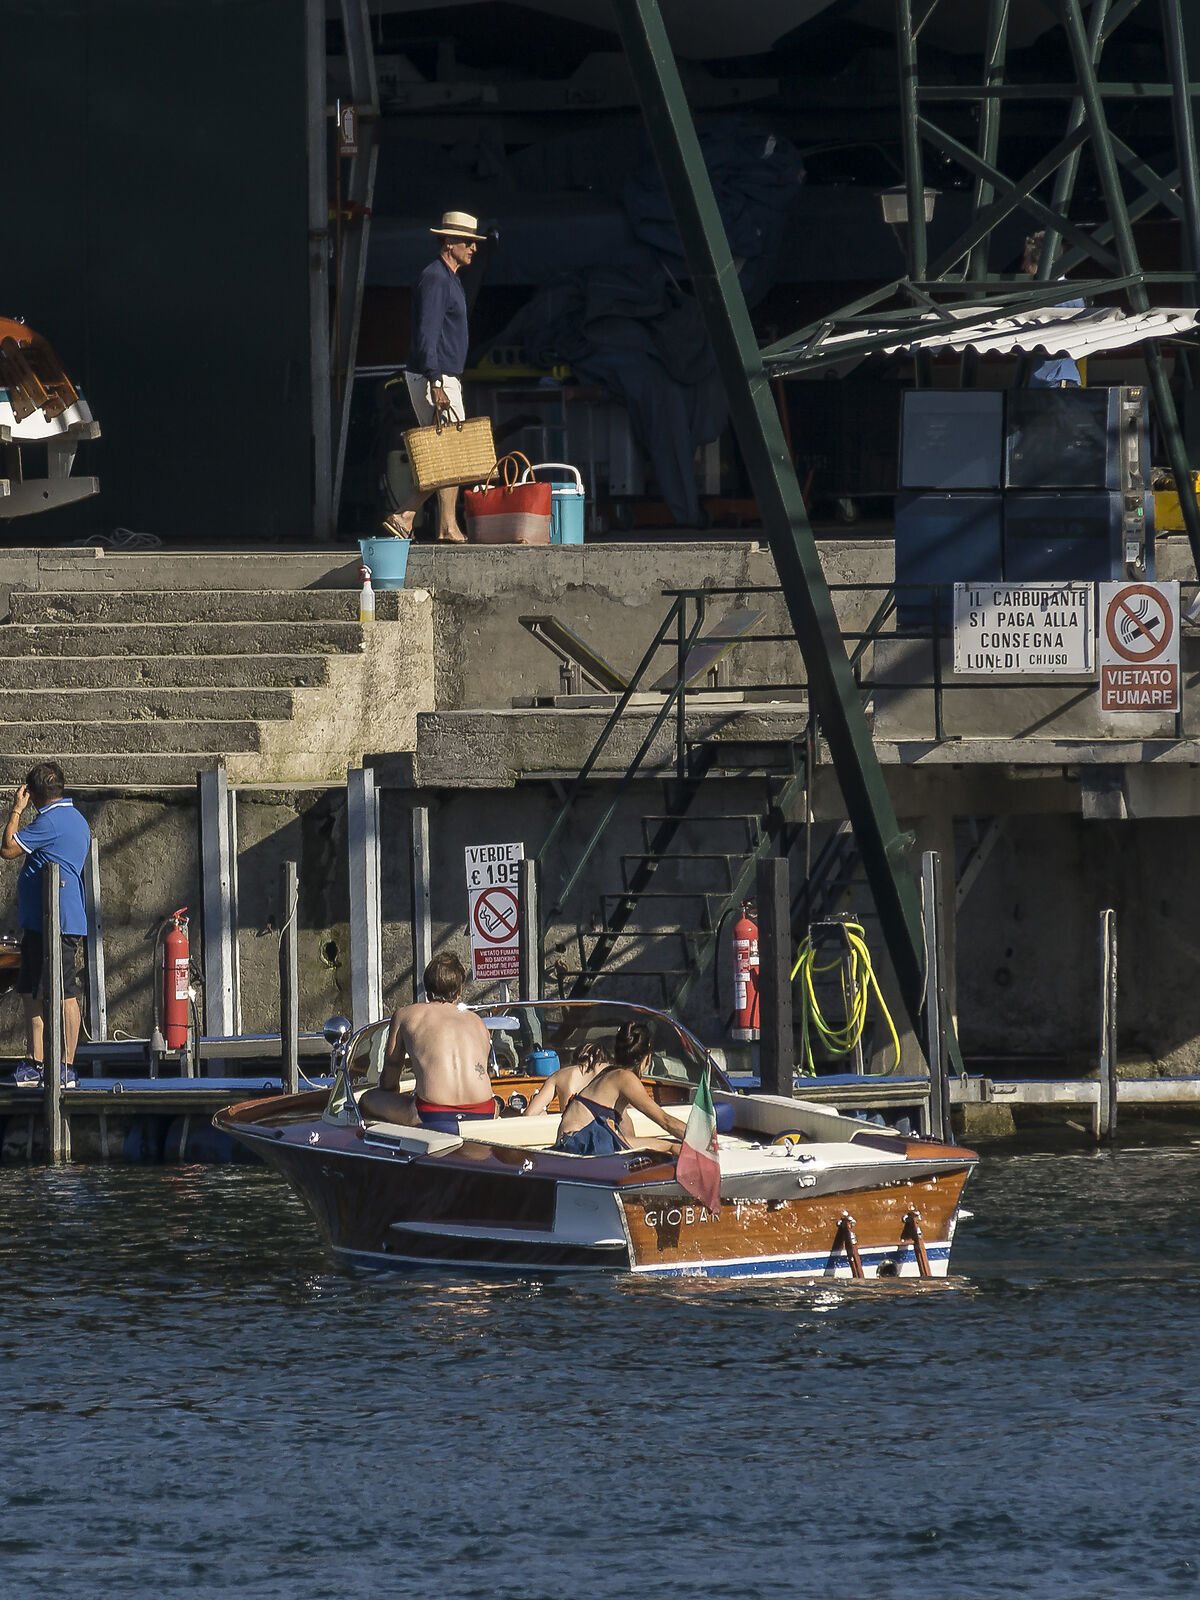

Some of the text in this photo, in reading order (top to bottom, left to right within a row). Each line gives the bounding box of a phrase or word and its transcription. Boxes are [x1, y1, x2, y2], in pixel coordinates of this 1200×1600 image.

[969, 591, 1086, 607] IL CARBURANTE
[969, 612, 1078, 628] SI PAGA ALLA
[981, 632, 1064, 649] CONSEGNA
[1029, 654, 1068, 665] CHIUSO
[1107, 669, 1172, 685] VIETATO
[1107, 689, 1172, 705] FUMARE
[470, 845, 513, 863] VERDE
[471, 864, 520, 886] € 1.95
